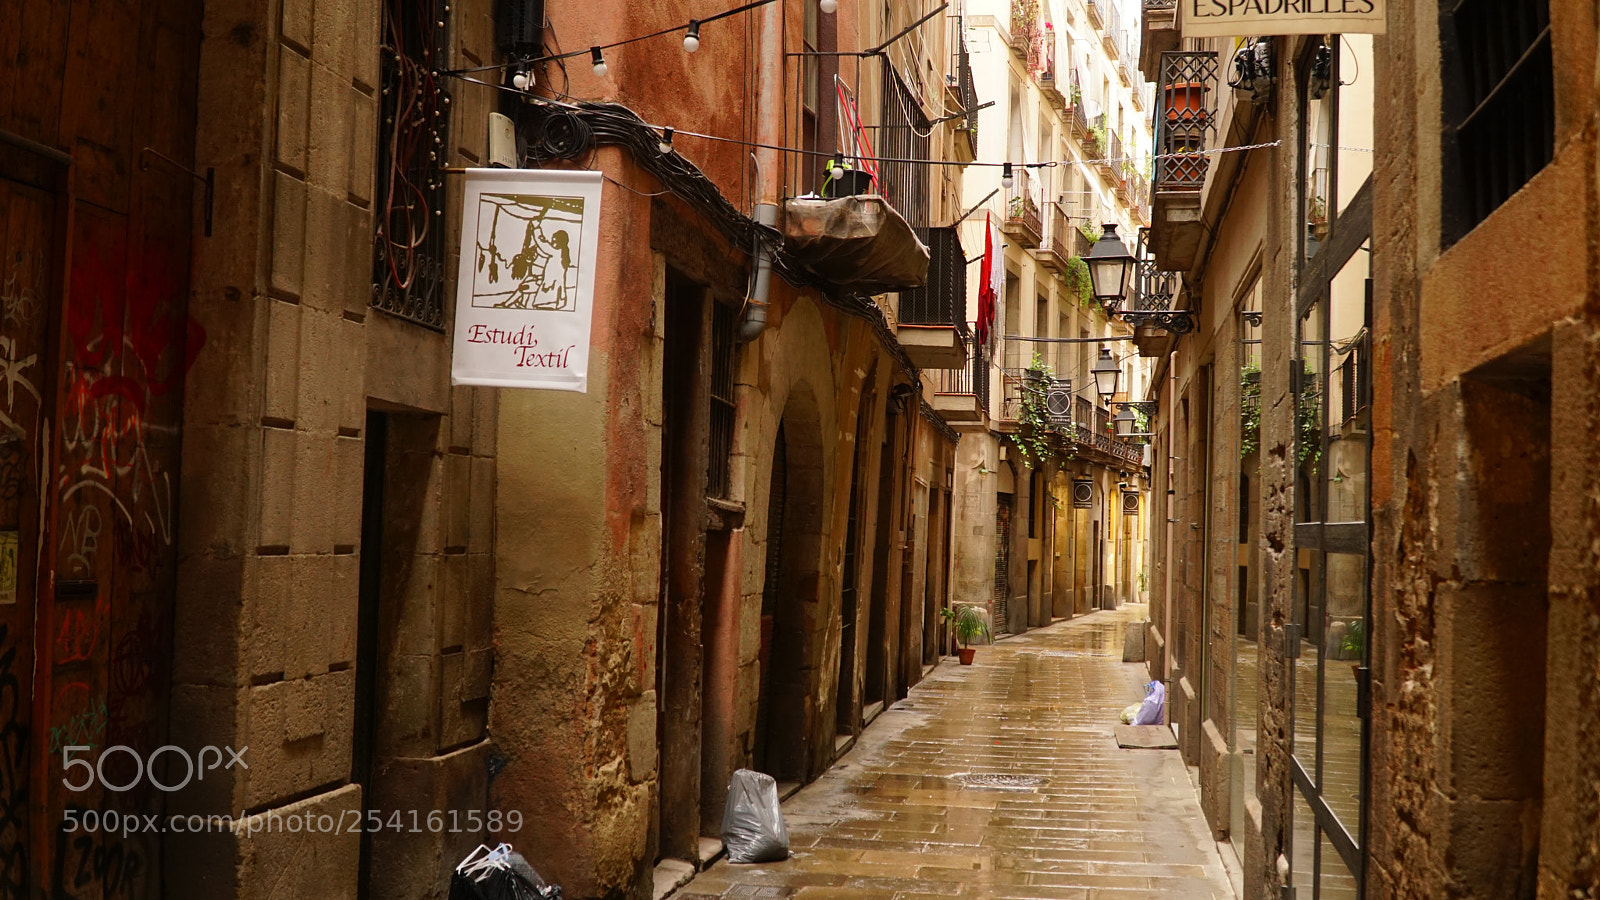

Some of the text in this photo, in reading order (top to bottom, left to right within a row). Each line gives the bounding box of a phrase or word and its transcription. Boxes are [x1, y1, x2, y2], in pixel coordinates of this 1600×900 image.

[1193, 0, 1375, 17] ESPADRILLES
[467, 324, 535, 346] Estudi
[513, 343, 576, 369] Textil
